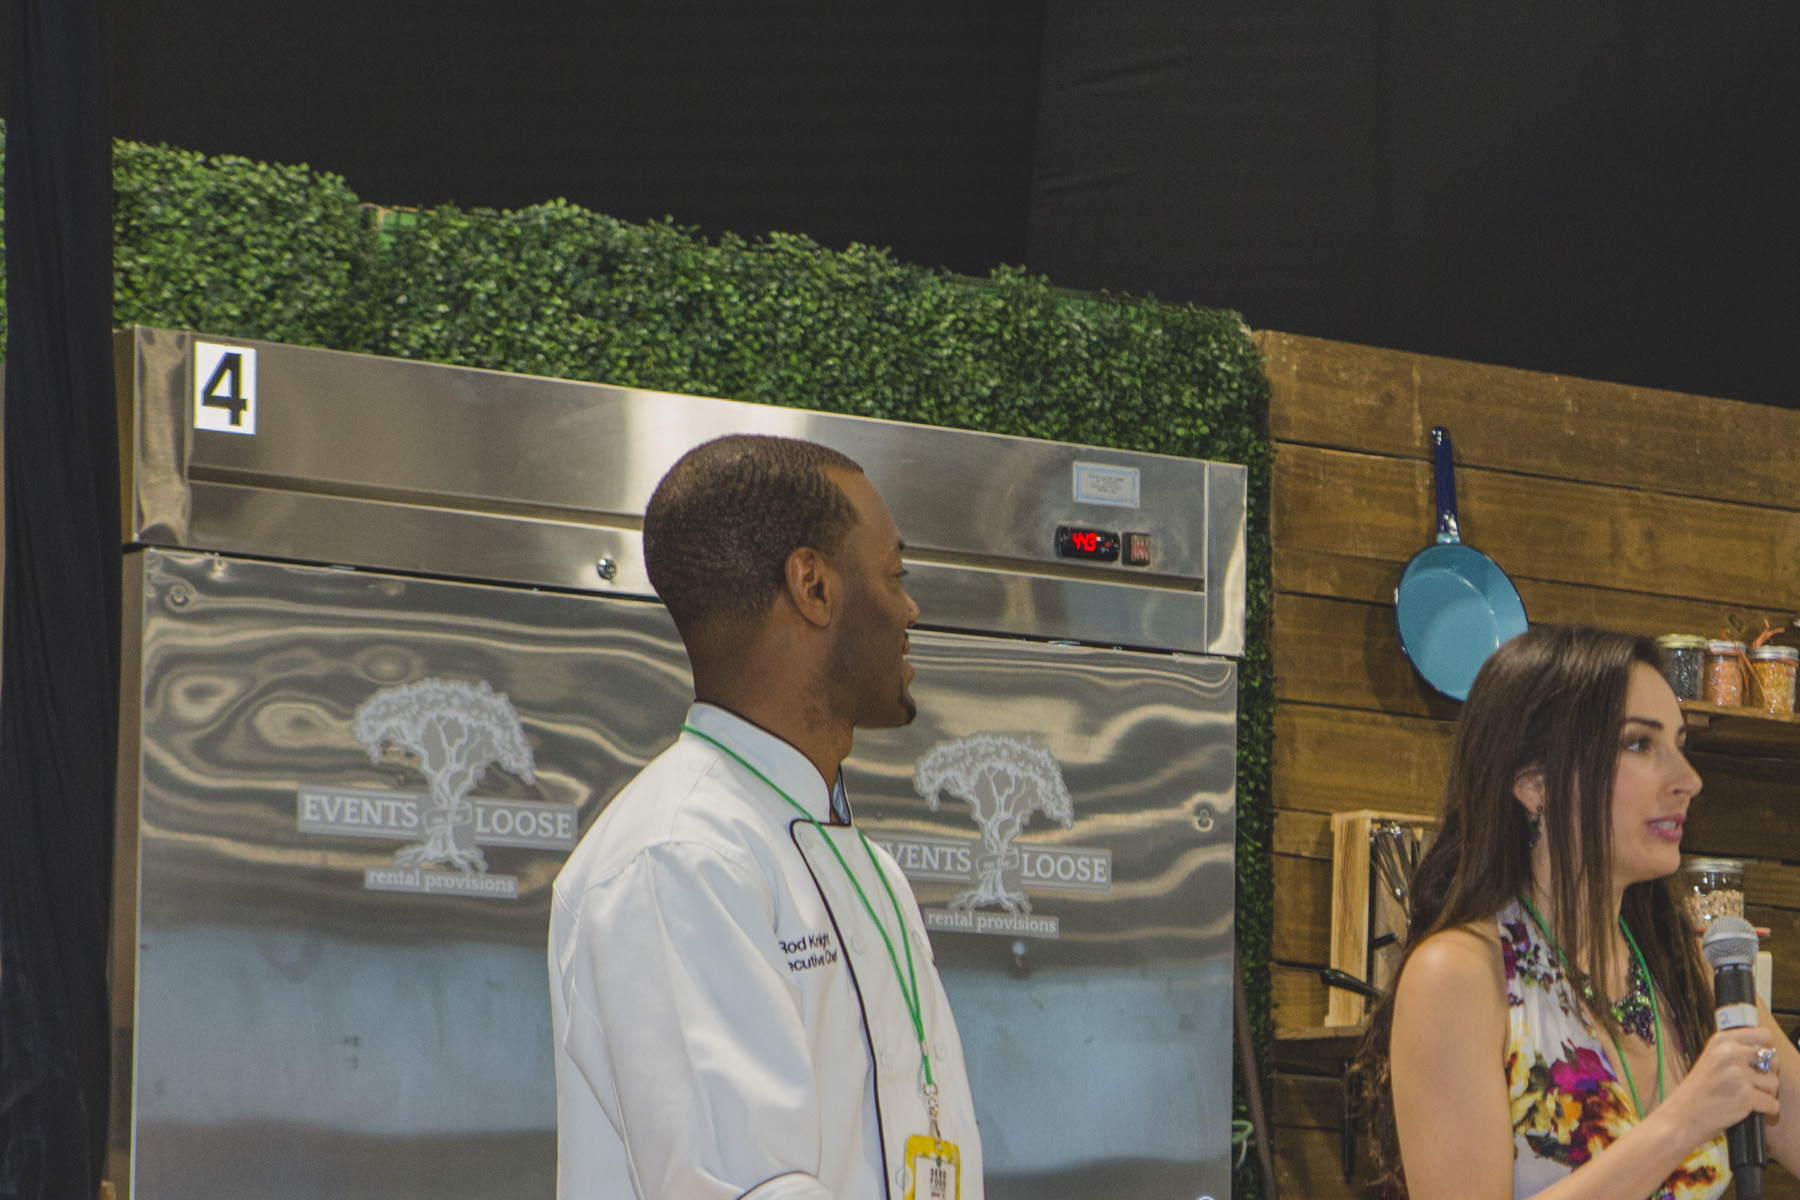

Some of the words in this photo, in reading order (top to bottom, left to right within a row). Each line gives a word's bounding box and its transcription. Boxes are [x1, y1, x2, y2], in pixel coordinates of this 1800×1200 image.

[201, 352, 249, 427] 4
[303, 794, 419, 828] EVENTS
[475, 806, 572, 840] LOOSE
[369, 870, 420, 887] rental
[424, 871, 516, 893] provisions
[879, 842, 972, 873] VENTS
[1021, 852, 1107, 883] LOOSE
[927, 911, 973, 927] rental
[977, 914, 1057, 934] provisions
